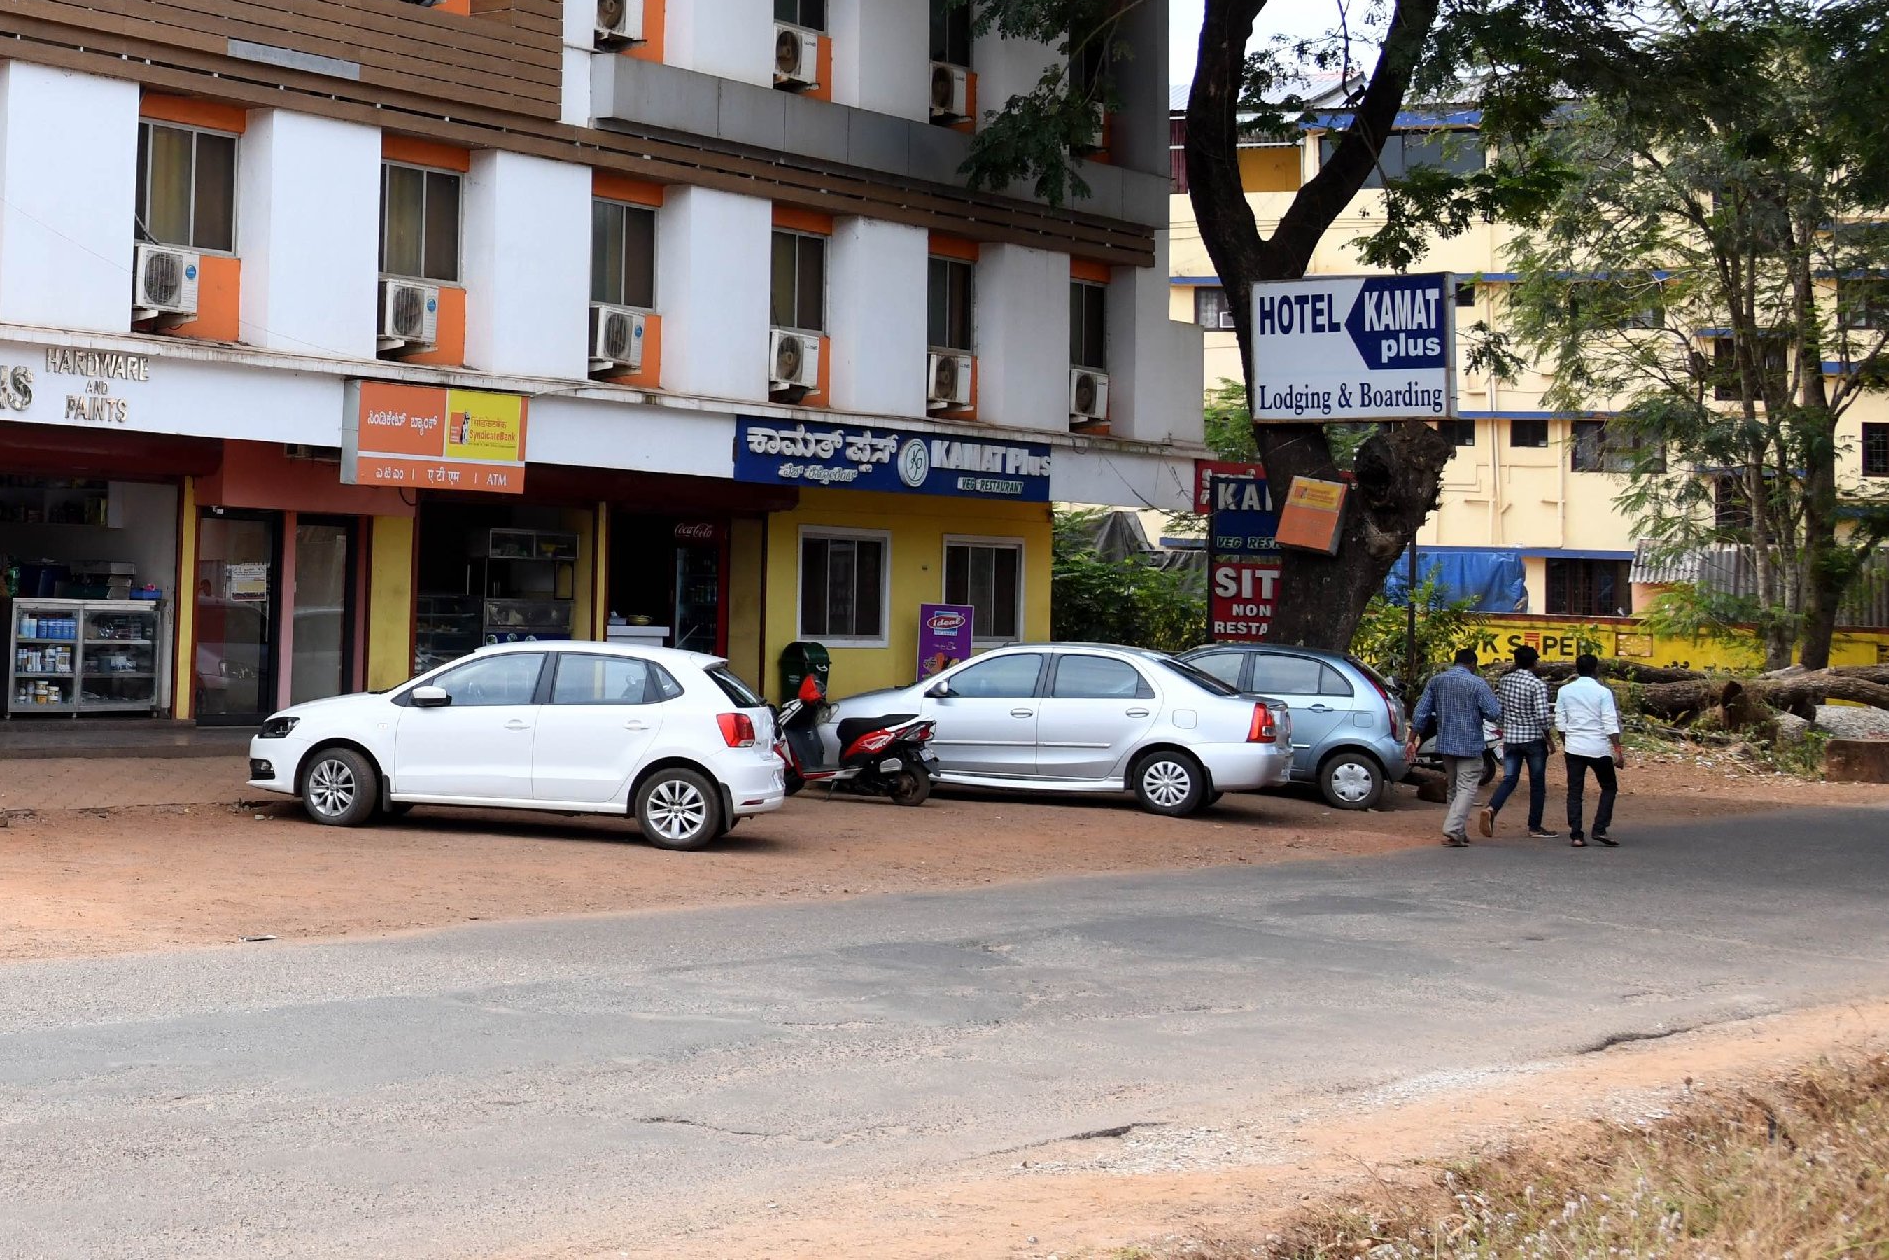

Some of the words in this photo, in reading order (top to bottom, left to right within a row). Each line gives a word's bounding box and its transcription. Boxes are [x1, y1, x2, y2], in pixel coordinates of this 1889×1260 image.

[1259, 294, 1341, 335] HOTEL
[1364, 288, 1440, 332] KAMAT
[1381, 333, 1441, 364] plus
[45, 348, 150, 381] HARDWARE
[85, 380, 108, 396] AND
[1259, 384, 1332, 415] Lodging
[1337, 383, 1353, 409] &
[1359, 381, 1443, 413] Boarding
[64, 395, 127, 423] PAINTS
[469, 430, 516, 443] SyndicateBank
[930, 440, 1006, 473] KAMAT
[1006, 447, 1050, 477] Plus
[487, 473, 507, 487] ATM
[960, 477, 976, 491] VEG
[978, 478, 1024, 494] RESTAURANT
[1217, 536, 1242, 550] VEG
[1232, 604, 1271, 617] NON
[933, 617, 961, 627] Ideal
